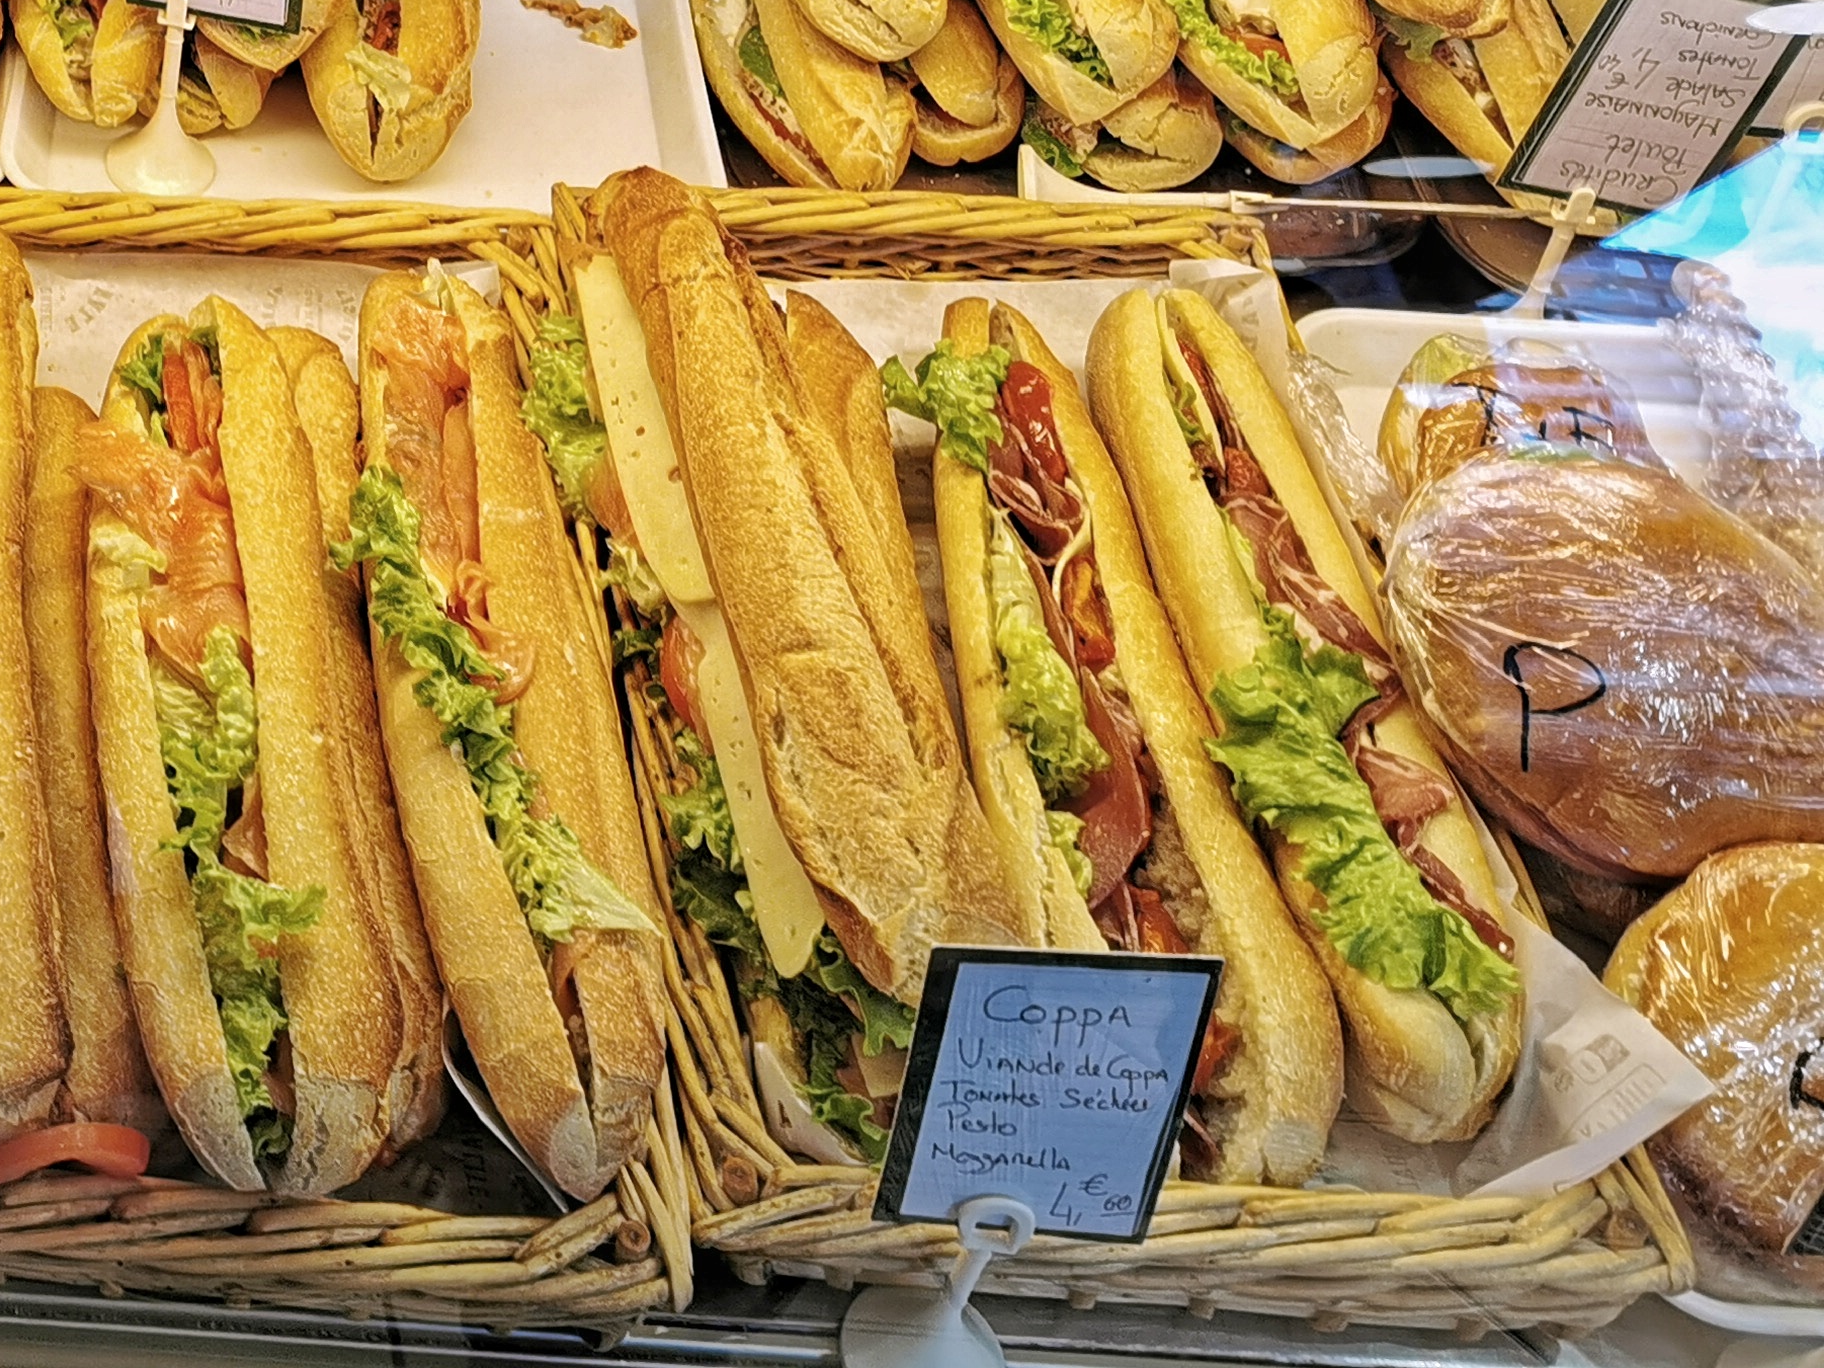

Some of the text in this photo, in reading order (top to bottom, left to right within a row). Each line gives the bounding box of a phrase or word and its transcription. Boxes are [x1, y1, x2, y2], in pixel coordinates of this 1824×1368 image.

[1606, 134, 1688, 176] Poulet
[1503, 640, 1606, 773] P
[1075, 1054, 1101, 1078] de
[937, 1100, 1018, 1136] Pesto
